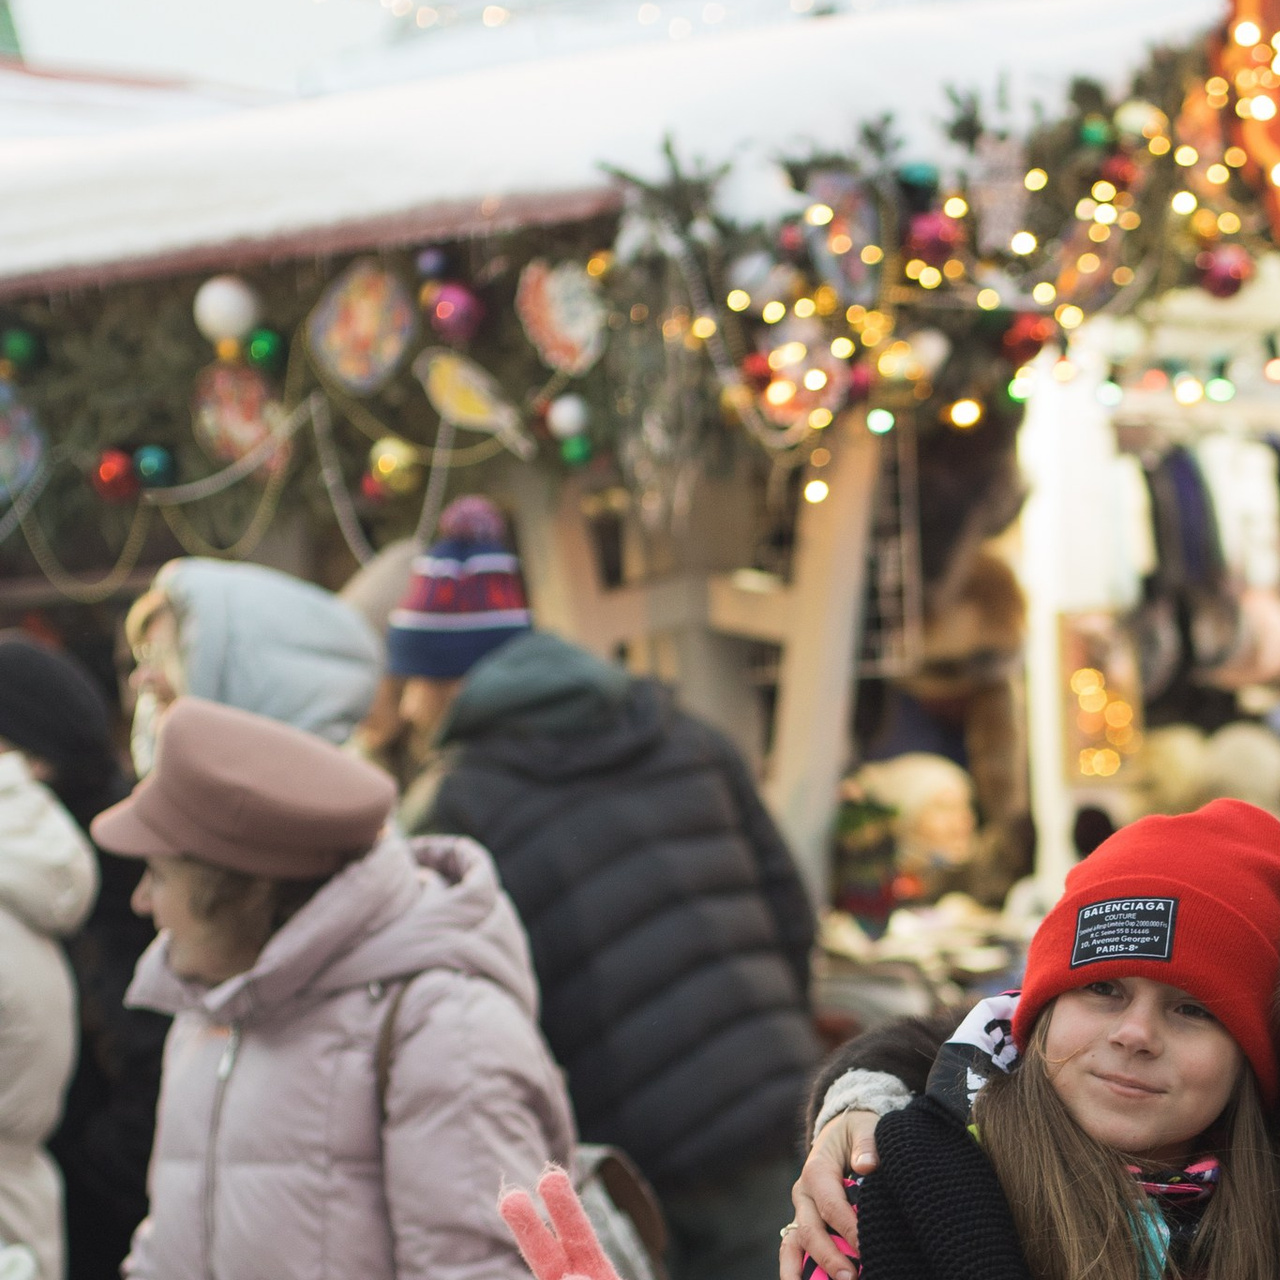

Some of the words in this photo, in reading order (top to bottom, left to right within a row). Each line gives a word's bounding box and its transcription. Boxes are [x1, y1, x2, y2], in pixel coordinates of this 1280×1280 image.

[1083, 902, 1165, 919] BALENCIAGA
[1104, 912, 1137, 922] COUTURE
[1091, 936, 1120, 946] Avenue
[1121, 935, 1160, 943] George-V
